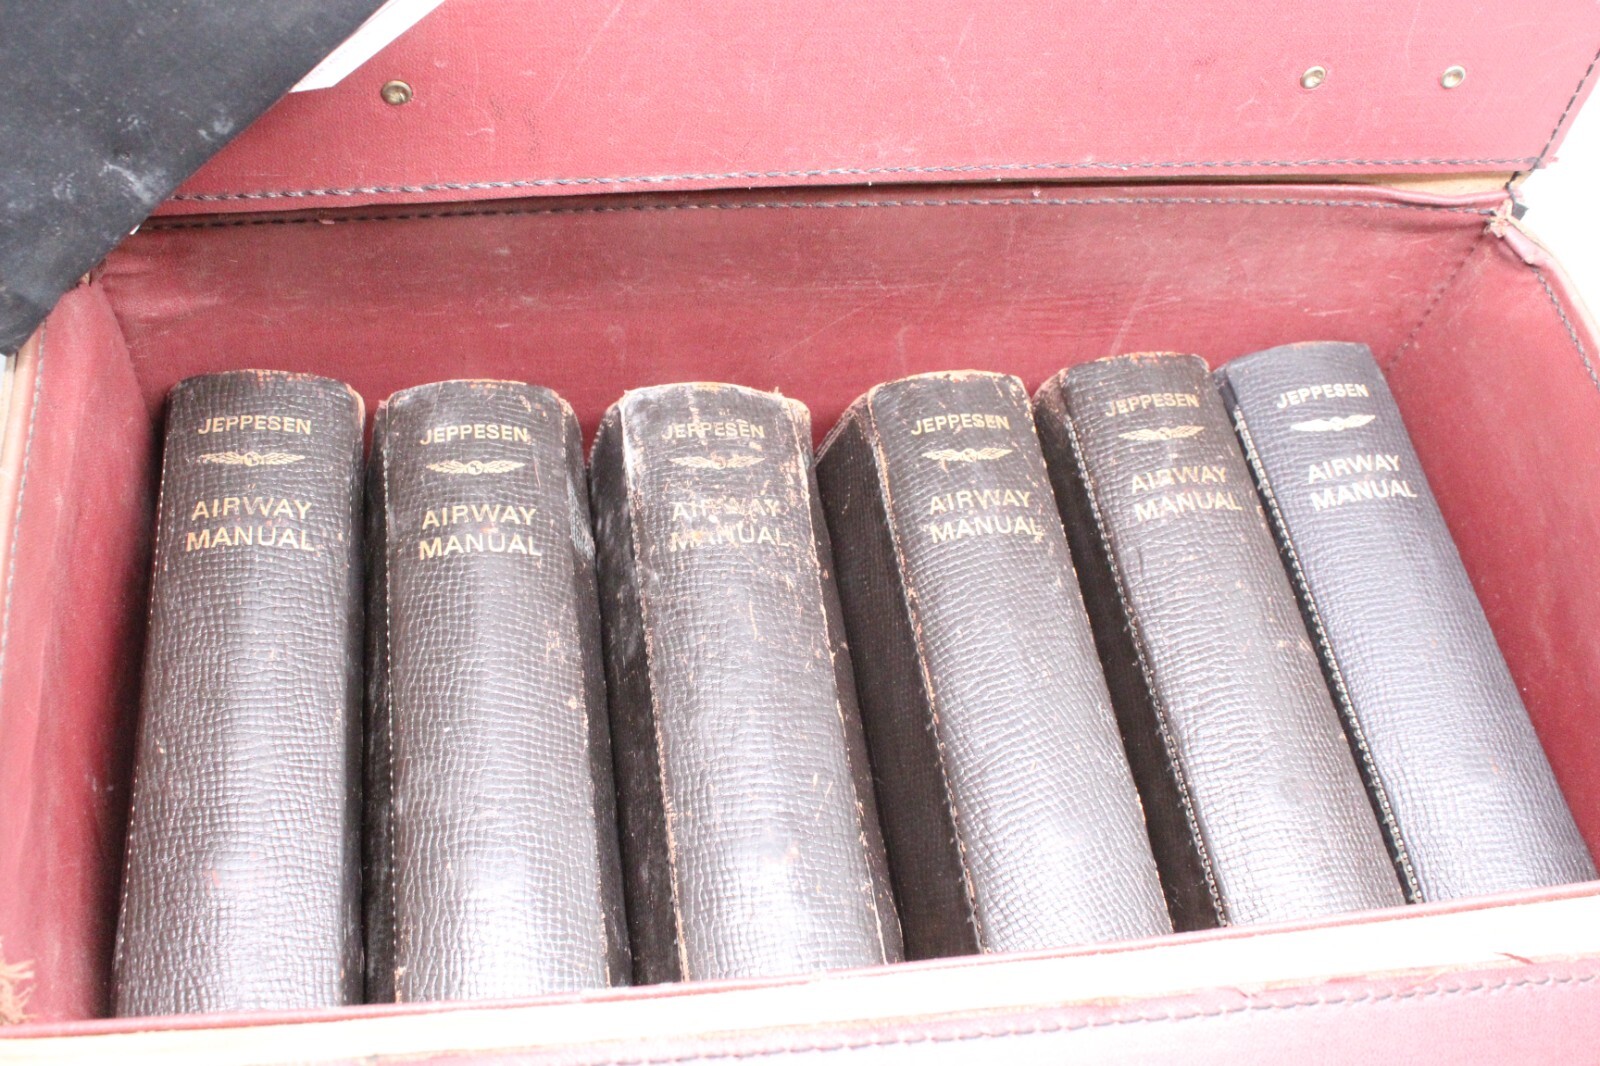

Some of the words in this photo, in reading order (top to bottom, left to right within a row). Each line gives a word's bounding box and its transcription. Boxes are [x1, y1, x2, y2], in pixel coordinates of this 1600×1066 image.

[1105, 393, 1199, 417] JEPPESEN
[1277, 384, 1369, 409] JEPPESEN
[198, 415, 312, 435] JEPPESEN
[420, 425, 527, 445] JEPPESEN
[911, 413, 1009, 436] JEPPESEN
[1132, 465, 1227, 493] AIRWAY
[1308, 454, 1401, 484] AIRWAY
[929, 489, 1031, 515] AIRWAY
[1135, 492, 1242, 521] MANUAL
[1311, 480, 1417, 511] MANUAL
[192, 497, 312, 521] AIRWAY
[422, 504, 536, 530] AIRWAY
[186, 525, 315, 552] MANUAL
[931, 517, 1042, 543] MANUAL
[420, 534, 542, 559] MANUAL
